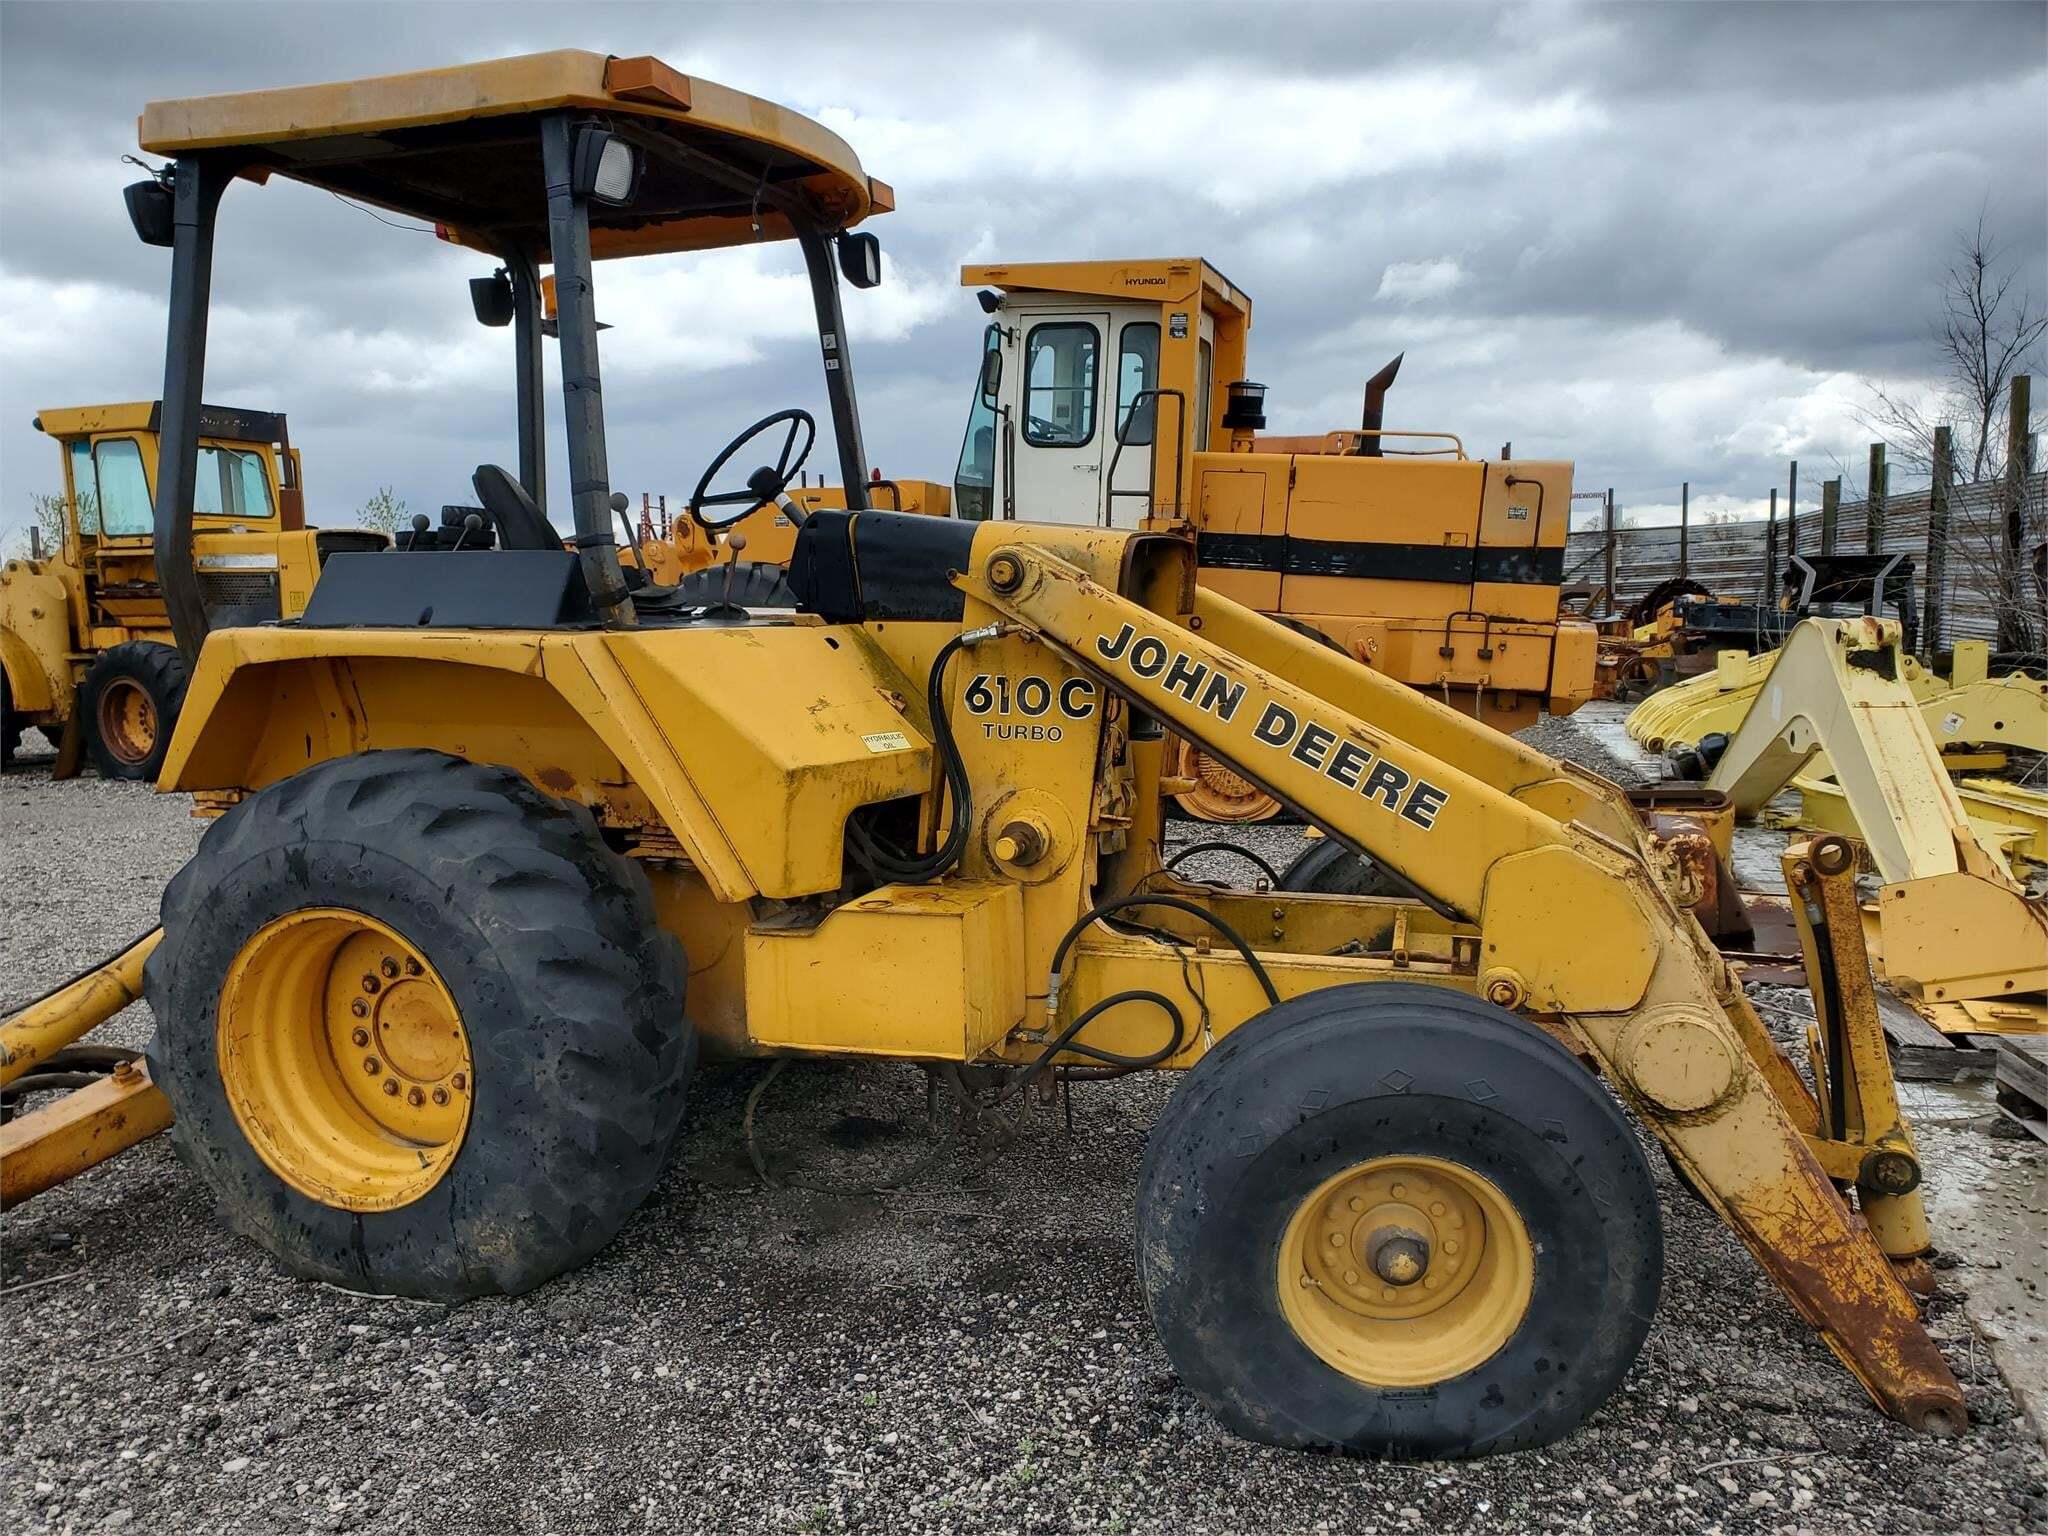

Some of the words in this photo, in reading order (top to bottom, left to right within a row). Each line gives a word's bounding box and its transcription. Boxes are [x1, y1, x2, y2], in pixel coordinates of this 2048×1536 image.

[1125, 278, 1166, 286] HYUNDAI
[963, 674, 1096, 720] 610C
[981, 722, 1064, 743] TURBO
[1096, 622, 1248, 723] JOHN
[1251, 700, 1450, 831] DEERE
[863, 733, 904, 743] HYDRAULIC
